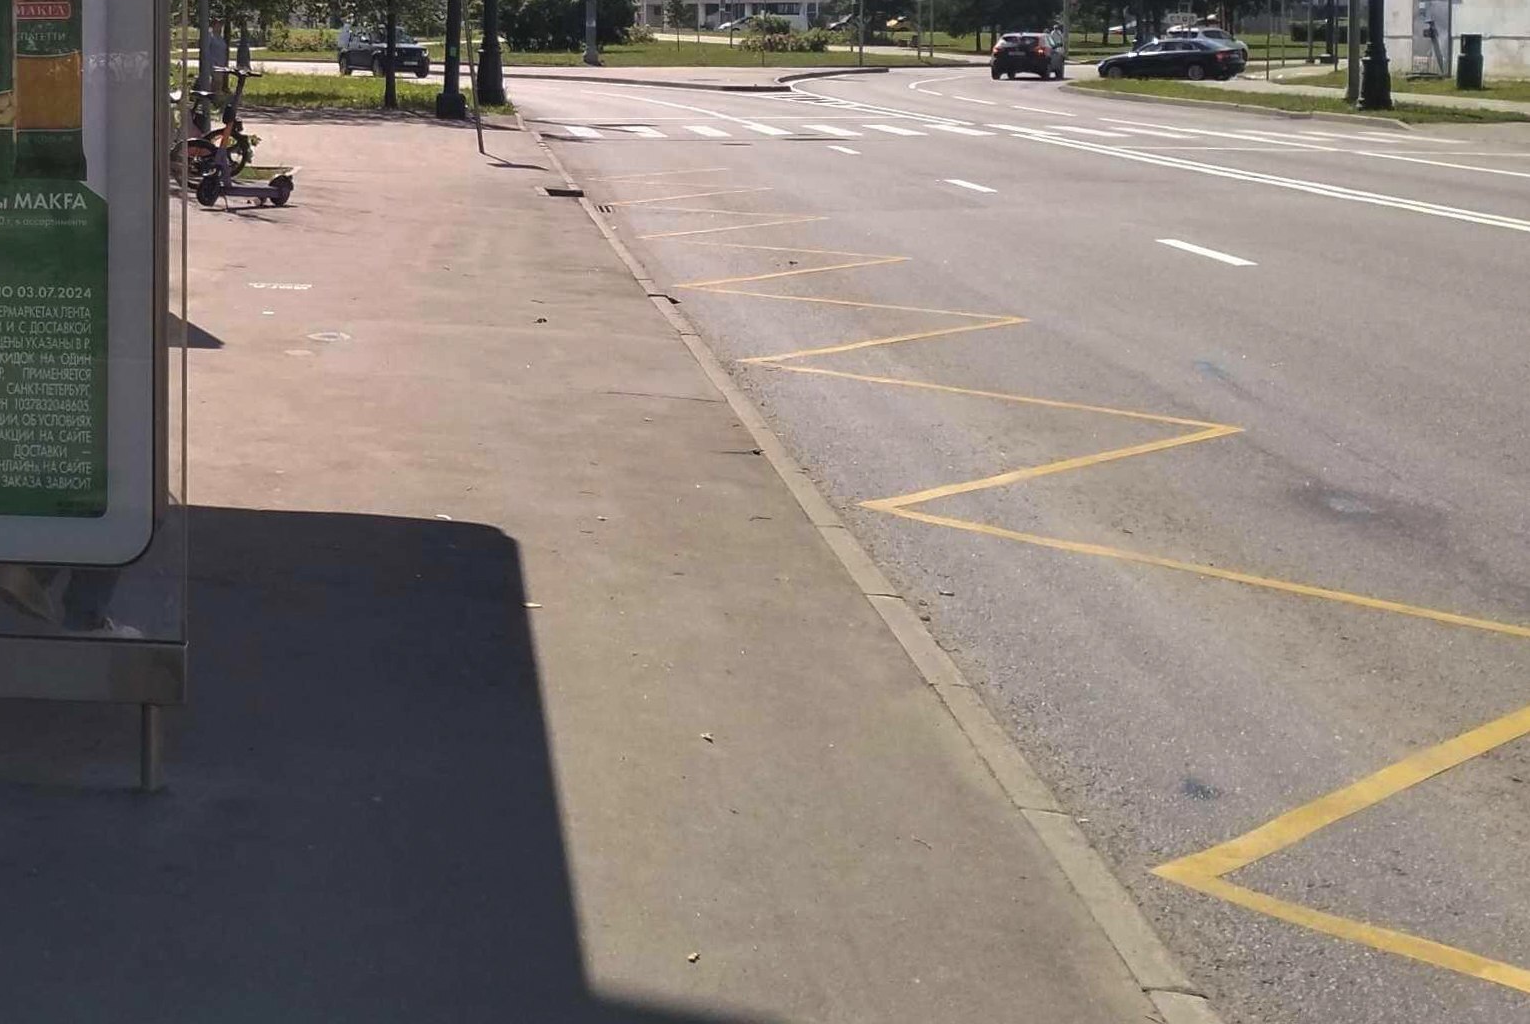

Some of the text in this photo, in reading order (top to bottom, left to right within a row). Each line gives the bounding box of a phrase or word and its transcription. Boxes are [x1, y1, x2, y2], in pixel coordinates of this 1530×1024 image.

[13, 192, 88, 211] MAKFA
[16, 285, 92, 299] 03.07.2024
[60, 306, 91, 319] ЛЕНТА
[29, 319, 91, 335] ДОСТАВКОЙ
